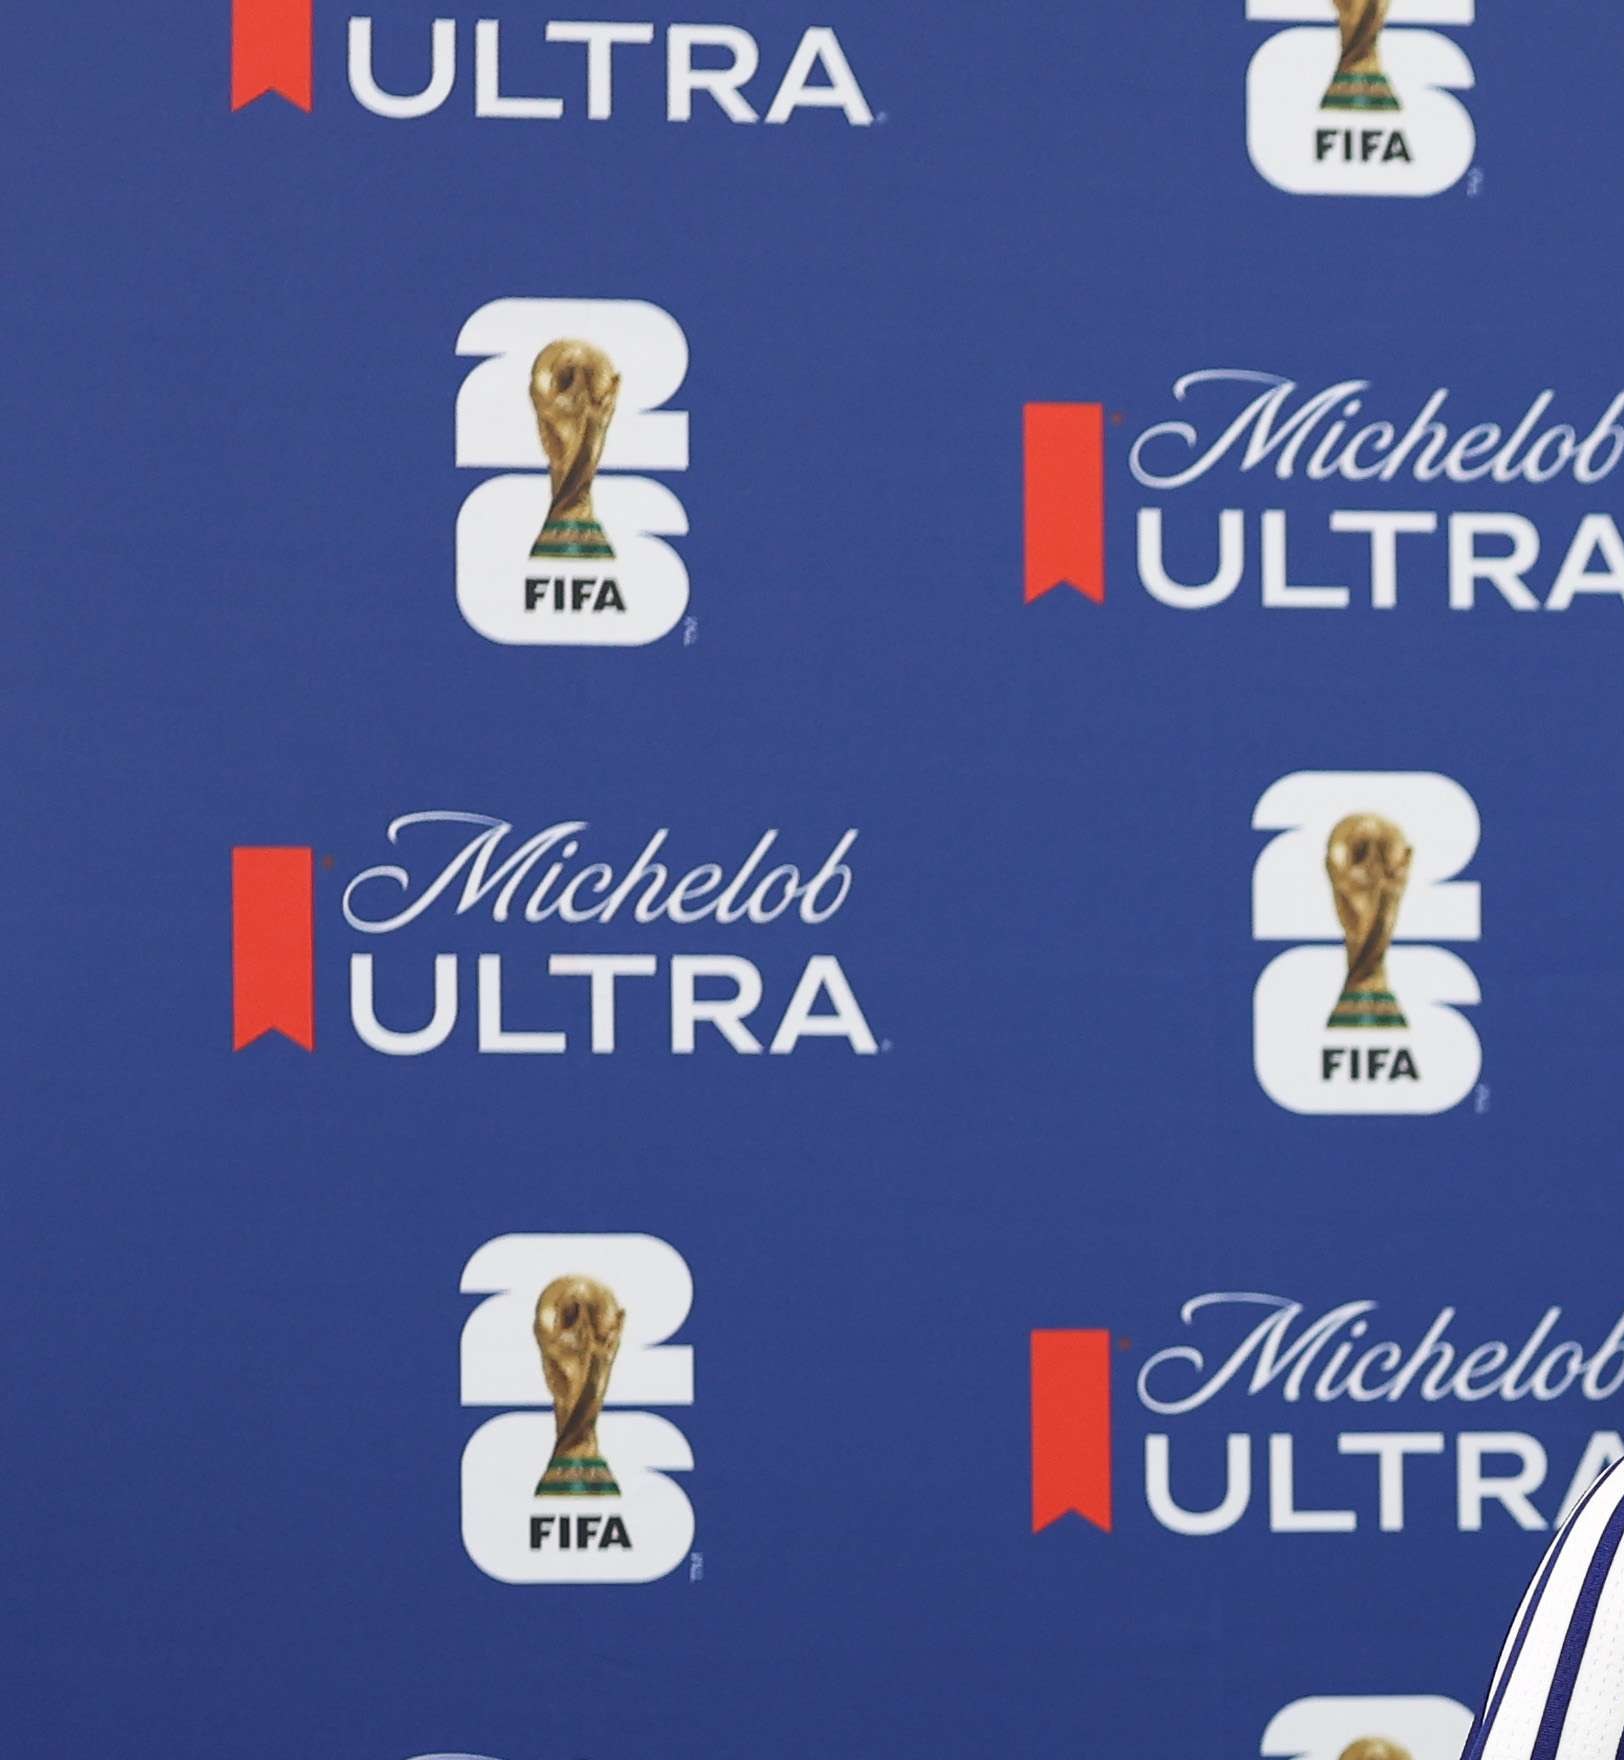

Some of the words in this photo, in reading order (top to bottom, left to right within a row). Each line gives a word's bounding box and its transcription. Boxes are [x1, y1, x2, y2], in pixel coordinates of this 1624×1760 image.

[349, 17, 873, 125] ULTRA
[1316, 130, 1411, 162] FIFA
[525, 579, 625, 611] FIFA
[343, 811, 858, 933] Michelob
[351, 954, 877, 1055] ULTRA
[1323, 1049, 1418, 1080] FIFA
[530, 1517, 631, 1549] FIFA
